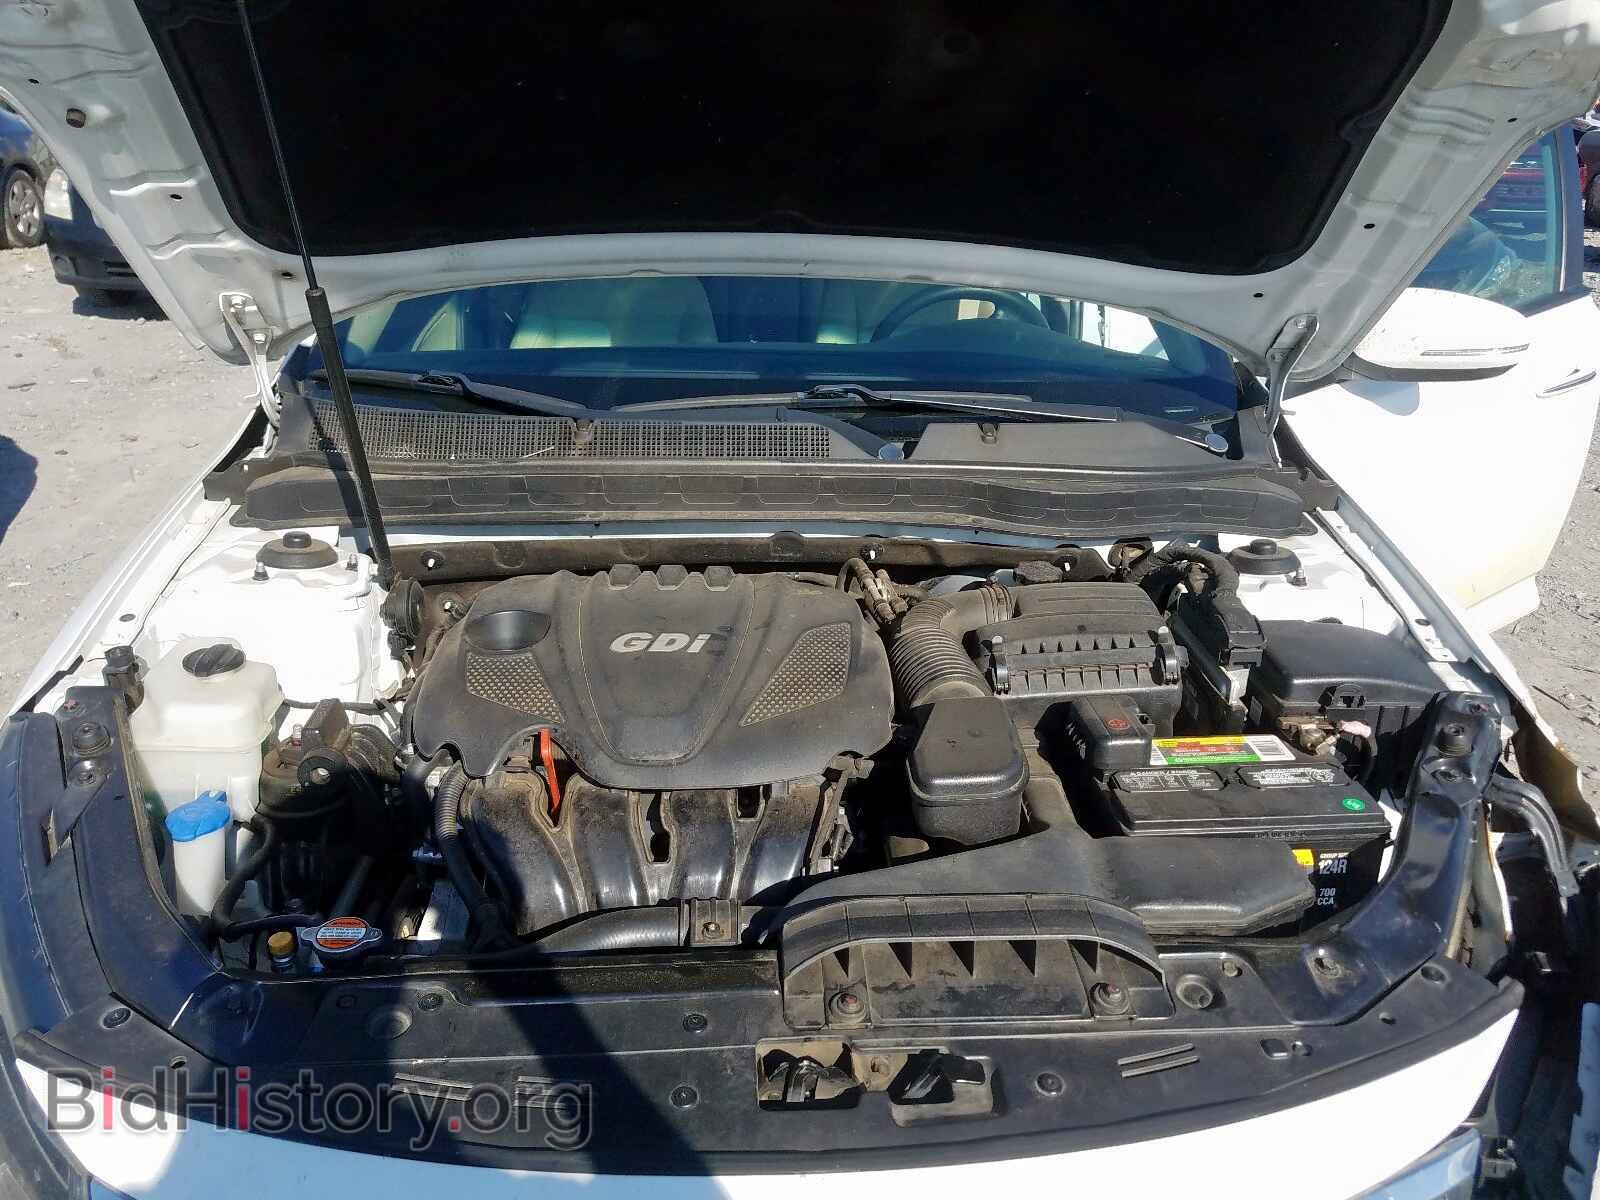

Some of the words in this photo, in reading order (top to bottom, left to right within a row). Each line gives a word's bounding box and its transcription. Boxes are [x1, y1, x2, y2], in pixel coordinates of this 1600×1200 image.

[609, 632, 712, 654] GDi
[1319, 859, 1347, 875] 124R
[1320, 888, 1336, 897] 700
[1318, 897, 1334, 906] CCA
